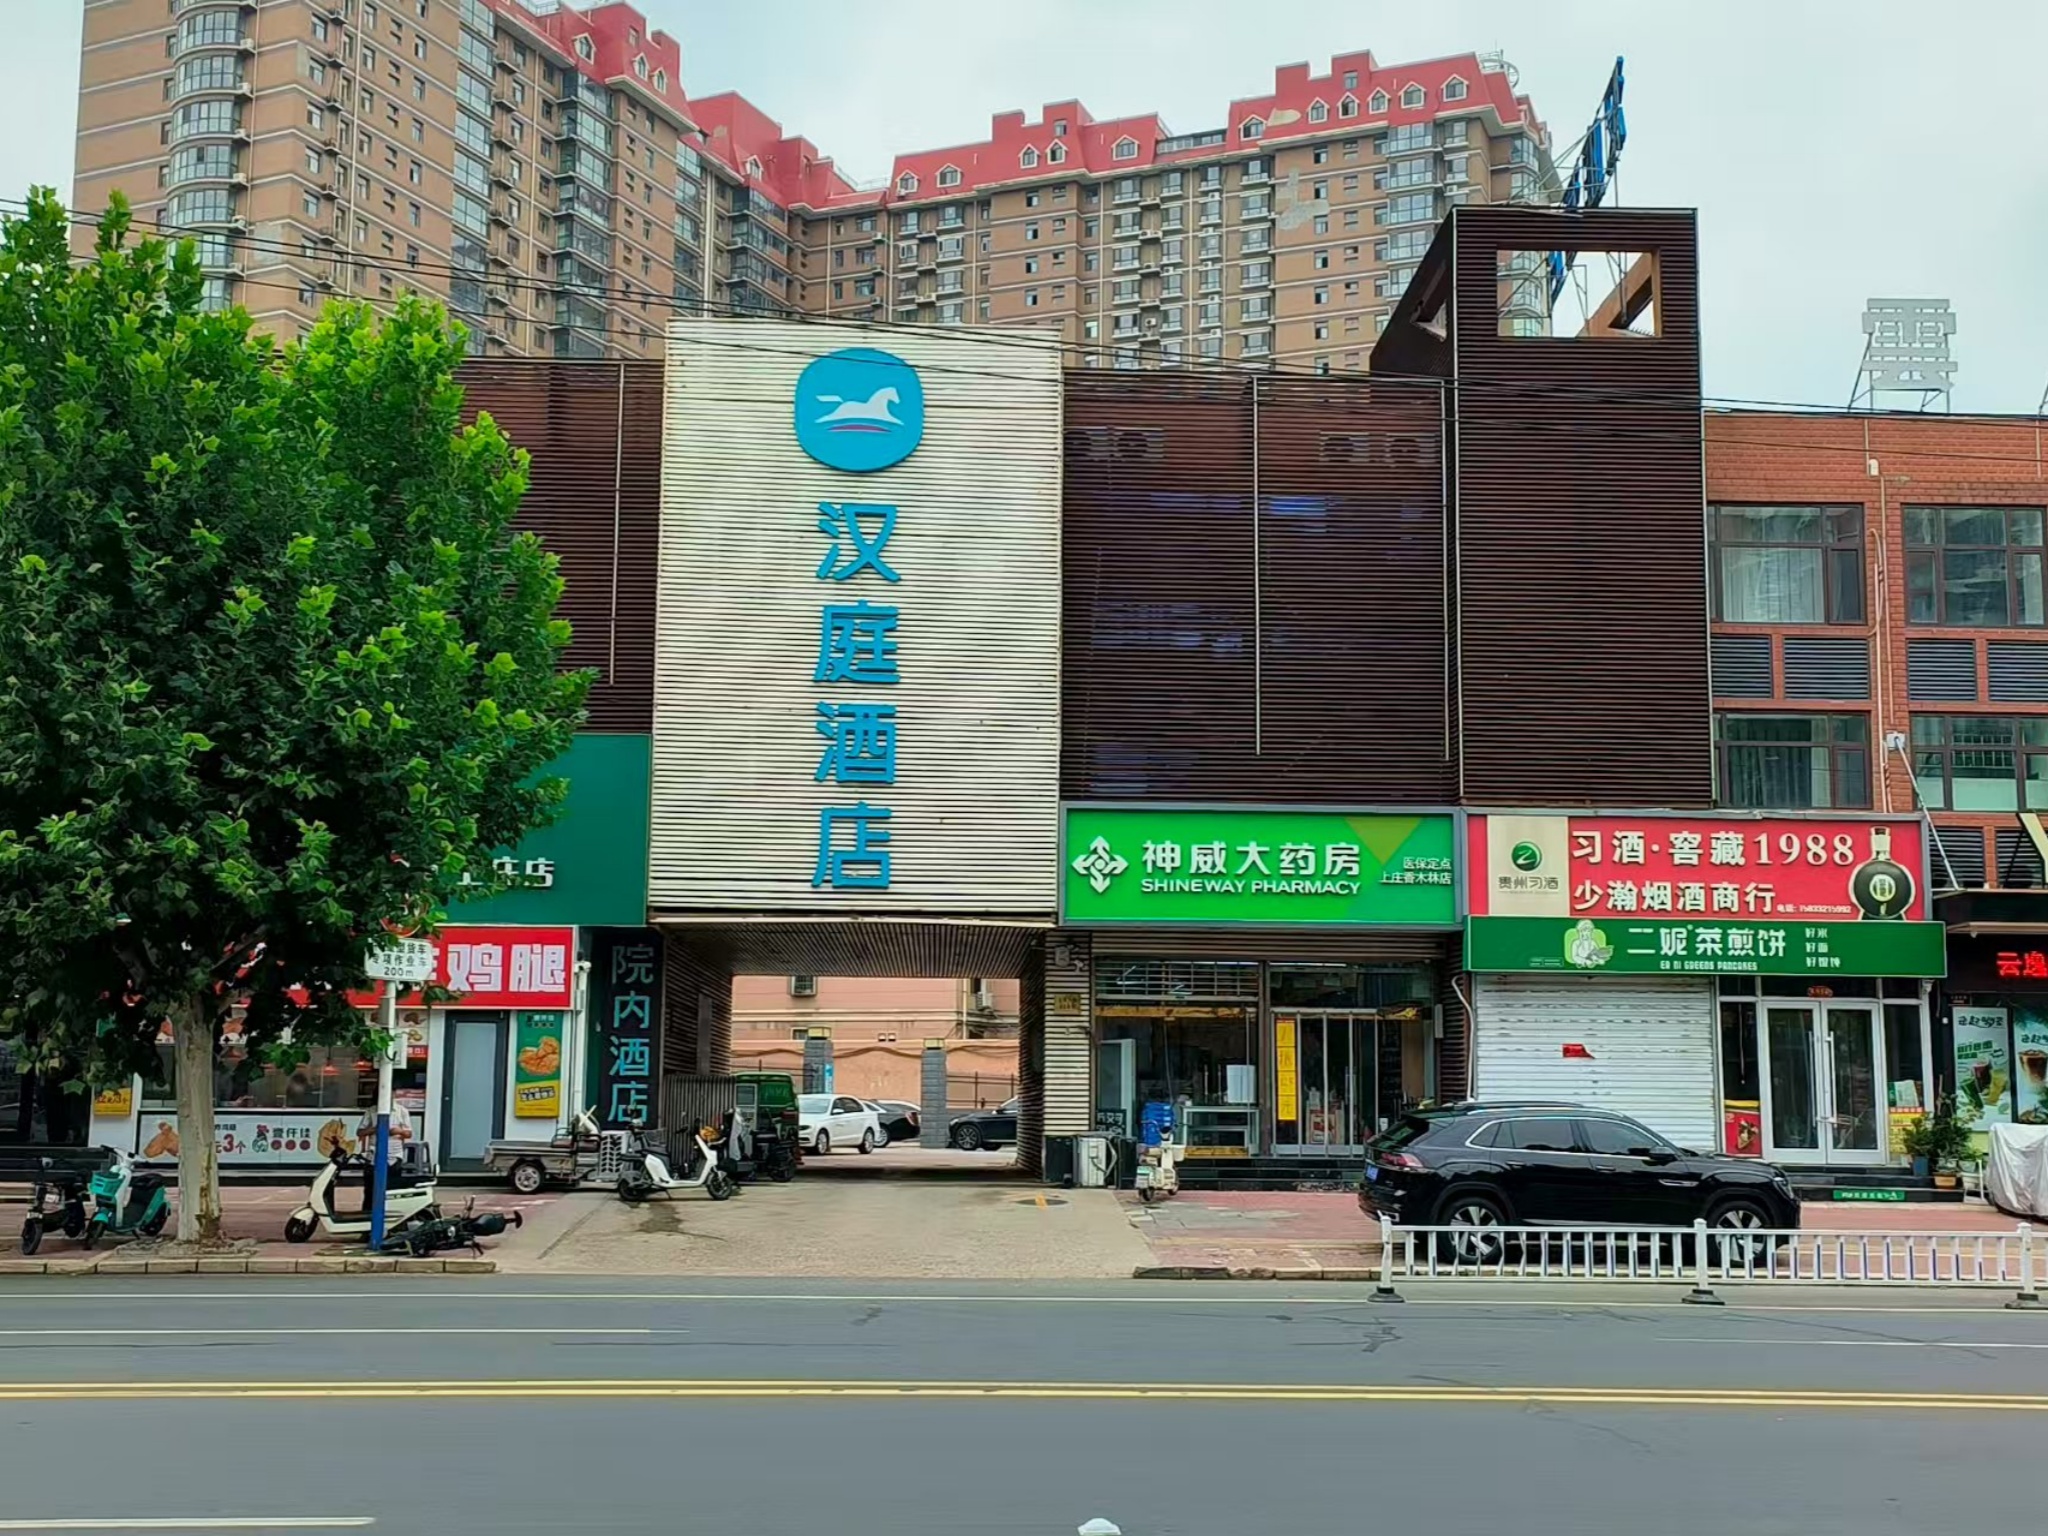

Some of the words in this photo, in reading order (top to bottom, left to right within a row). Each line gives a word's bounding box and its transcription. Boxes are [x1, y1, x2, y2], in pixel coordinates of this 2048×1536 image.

[812, 501, 902, 890] 汉庭酒店
[1142, 840, 1361, 875] 神威大药房
[1403, 856, 1452, 870] 医保定点
[1141, 878, 1246, 893] SHINEWAY
[1251, 880, 1361, 895] PHARMACY
[1499, 876, 1559, 890] 贵州习酒
[1573, 880, 1776, 912] 少瀚烟酒商行
[431, 943, 566, 993] 鸡腿
[607, 944, 654, 1123] 院内酒店
